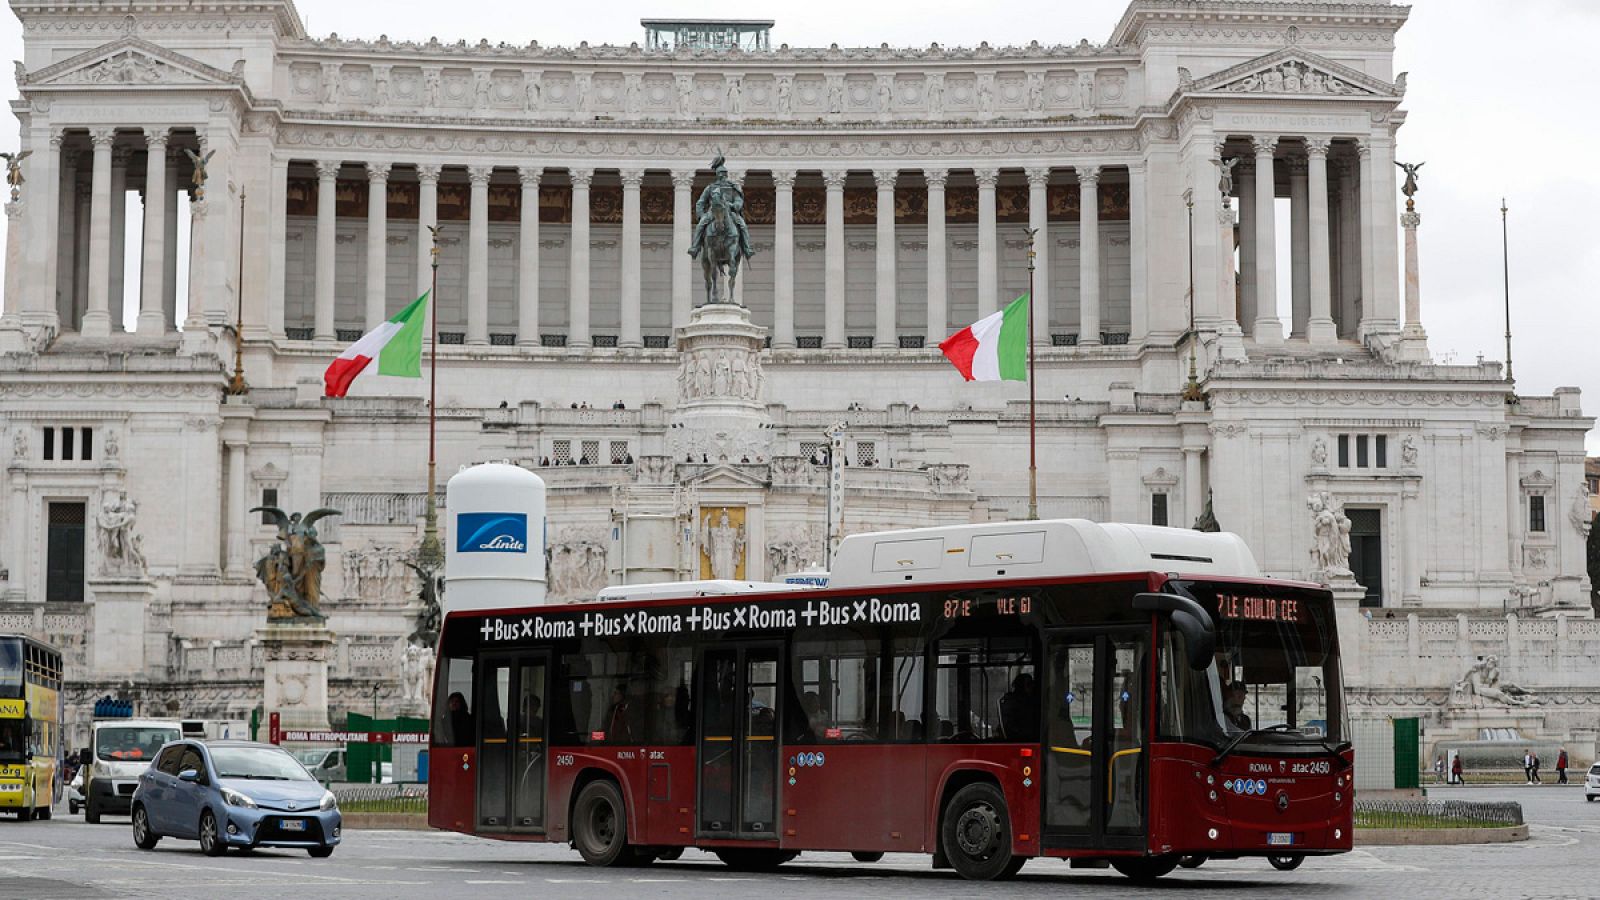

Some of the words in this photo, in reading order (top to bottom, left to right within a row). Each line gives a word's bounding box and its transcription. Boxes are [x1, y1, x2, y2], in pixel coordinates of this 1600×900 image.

[480, 534, 525, 550] Linde
[1244, 597, 1277, 620] GIULIO
[286, 732, 308, 742] ROMA
[309, 732, 369, 742] METROPOLITANE
[392, 733, 418, 742] LAVORI
[556, 755, 574, 766] 2450
[617, 751, 635, 760] ROMA
[649, 751, 665, 760] atac
[1249, 763, 1273, 773] ROMA
[1292, 762, 1309, 773] atac
[1310, 761, 1330, 774] 2450
